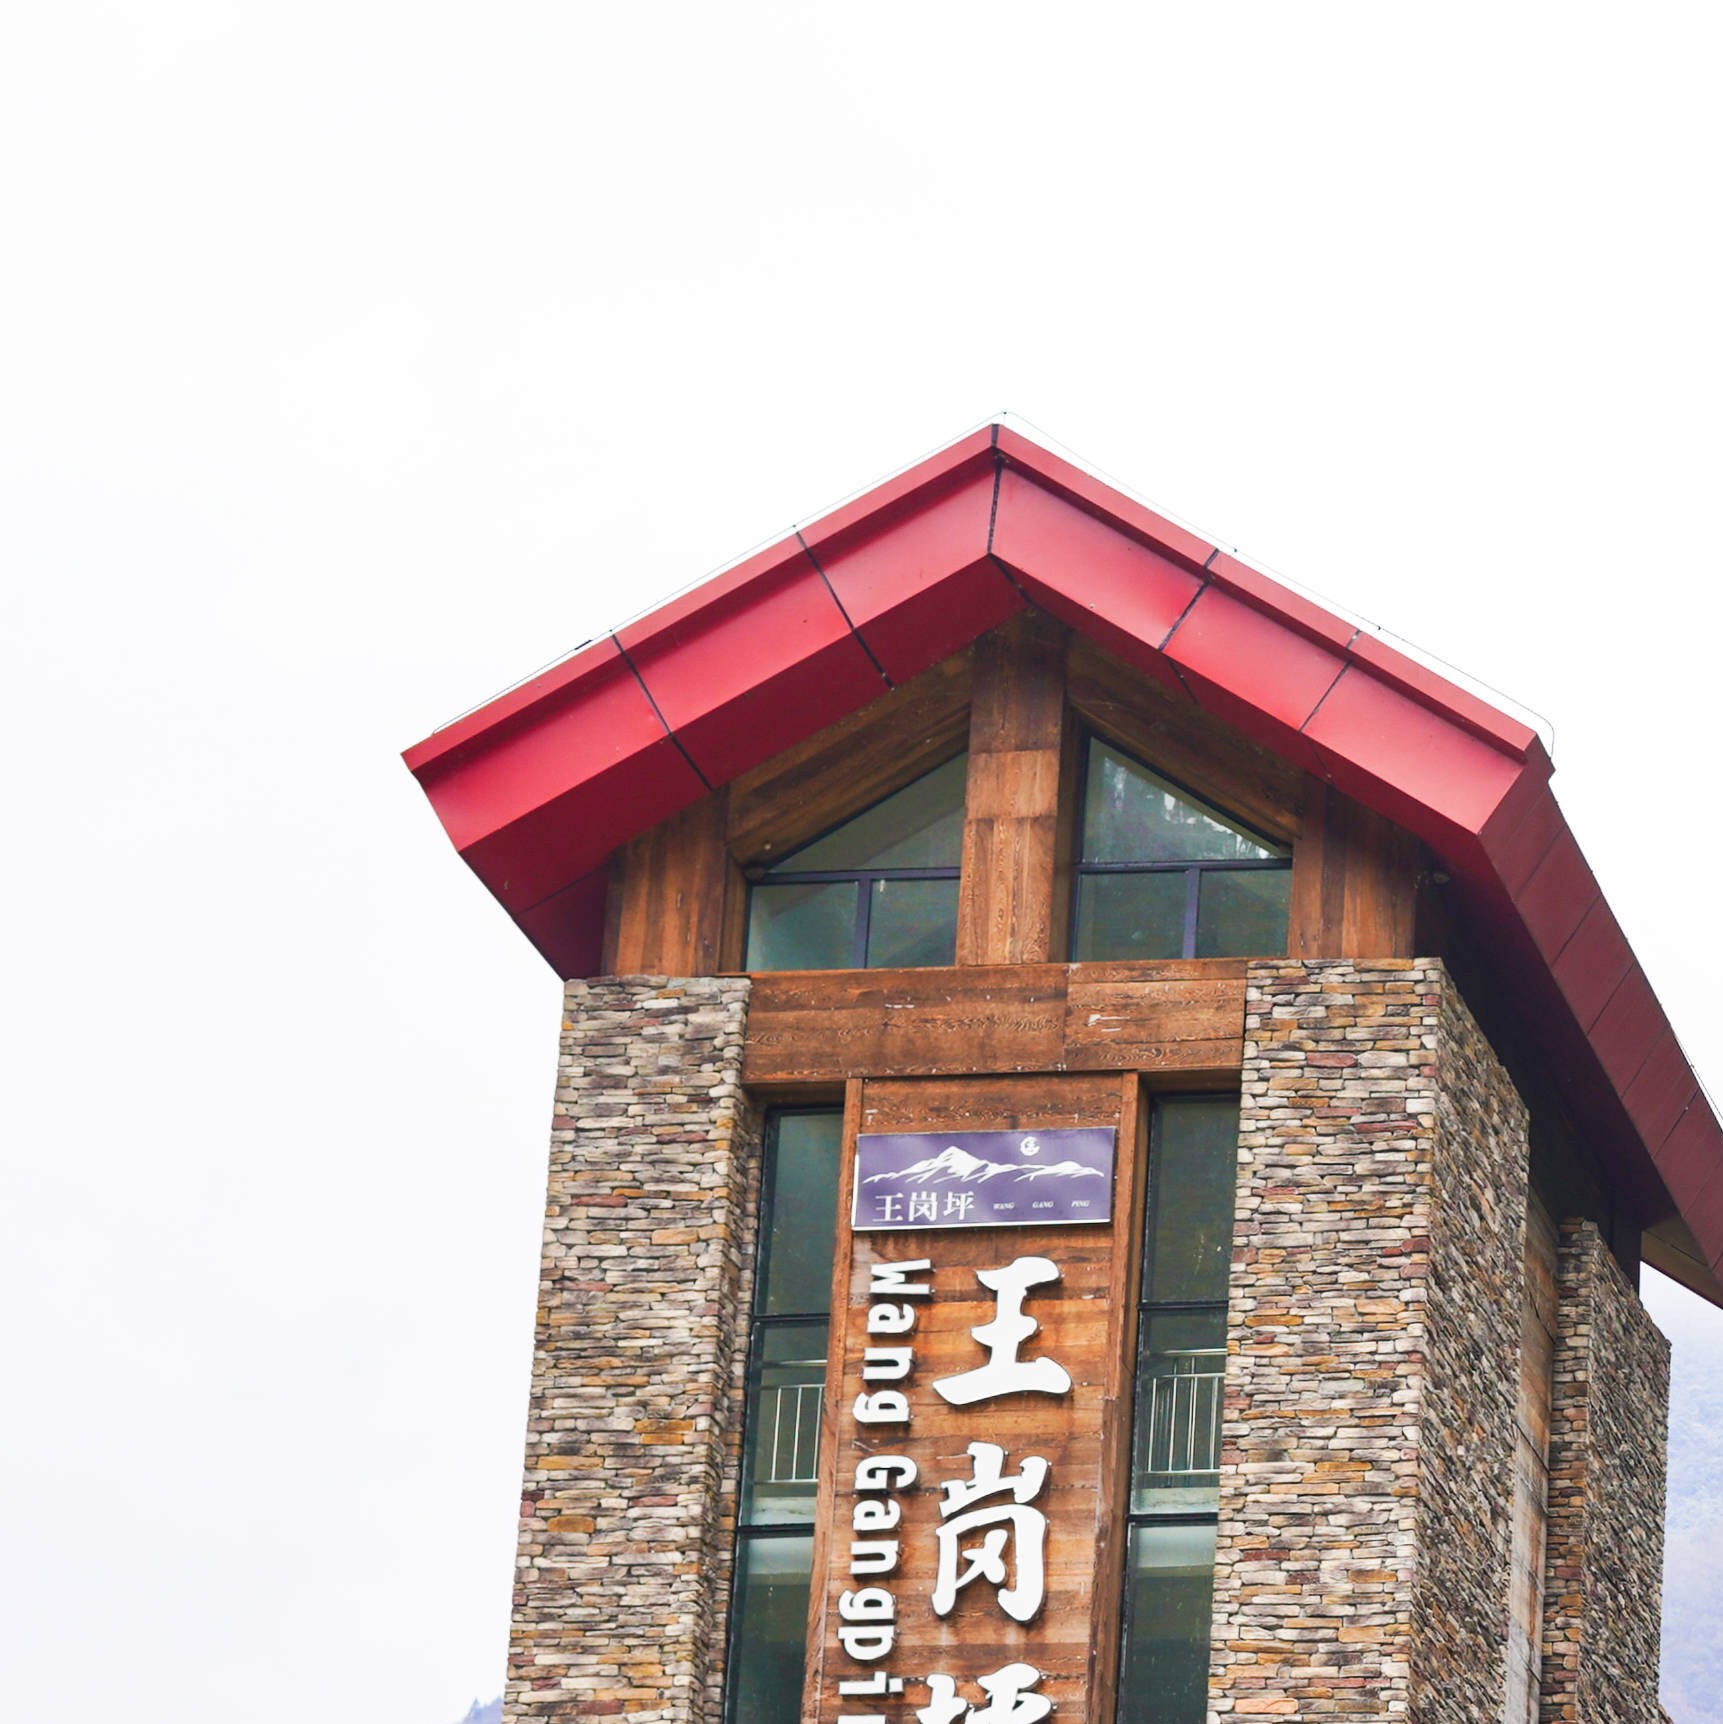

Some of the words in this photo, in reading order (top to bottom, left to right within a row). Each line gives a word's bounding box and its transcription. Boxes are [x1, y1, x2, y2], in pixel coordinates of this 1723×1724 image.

[873, 1191, 974, 1222] 王岗坪
[852, 1258, 935, 1425] Wang
